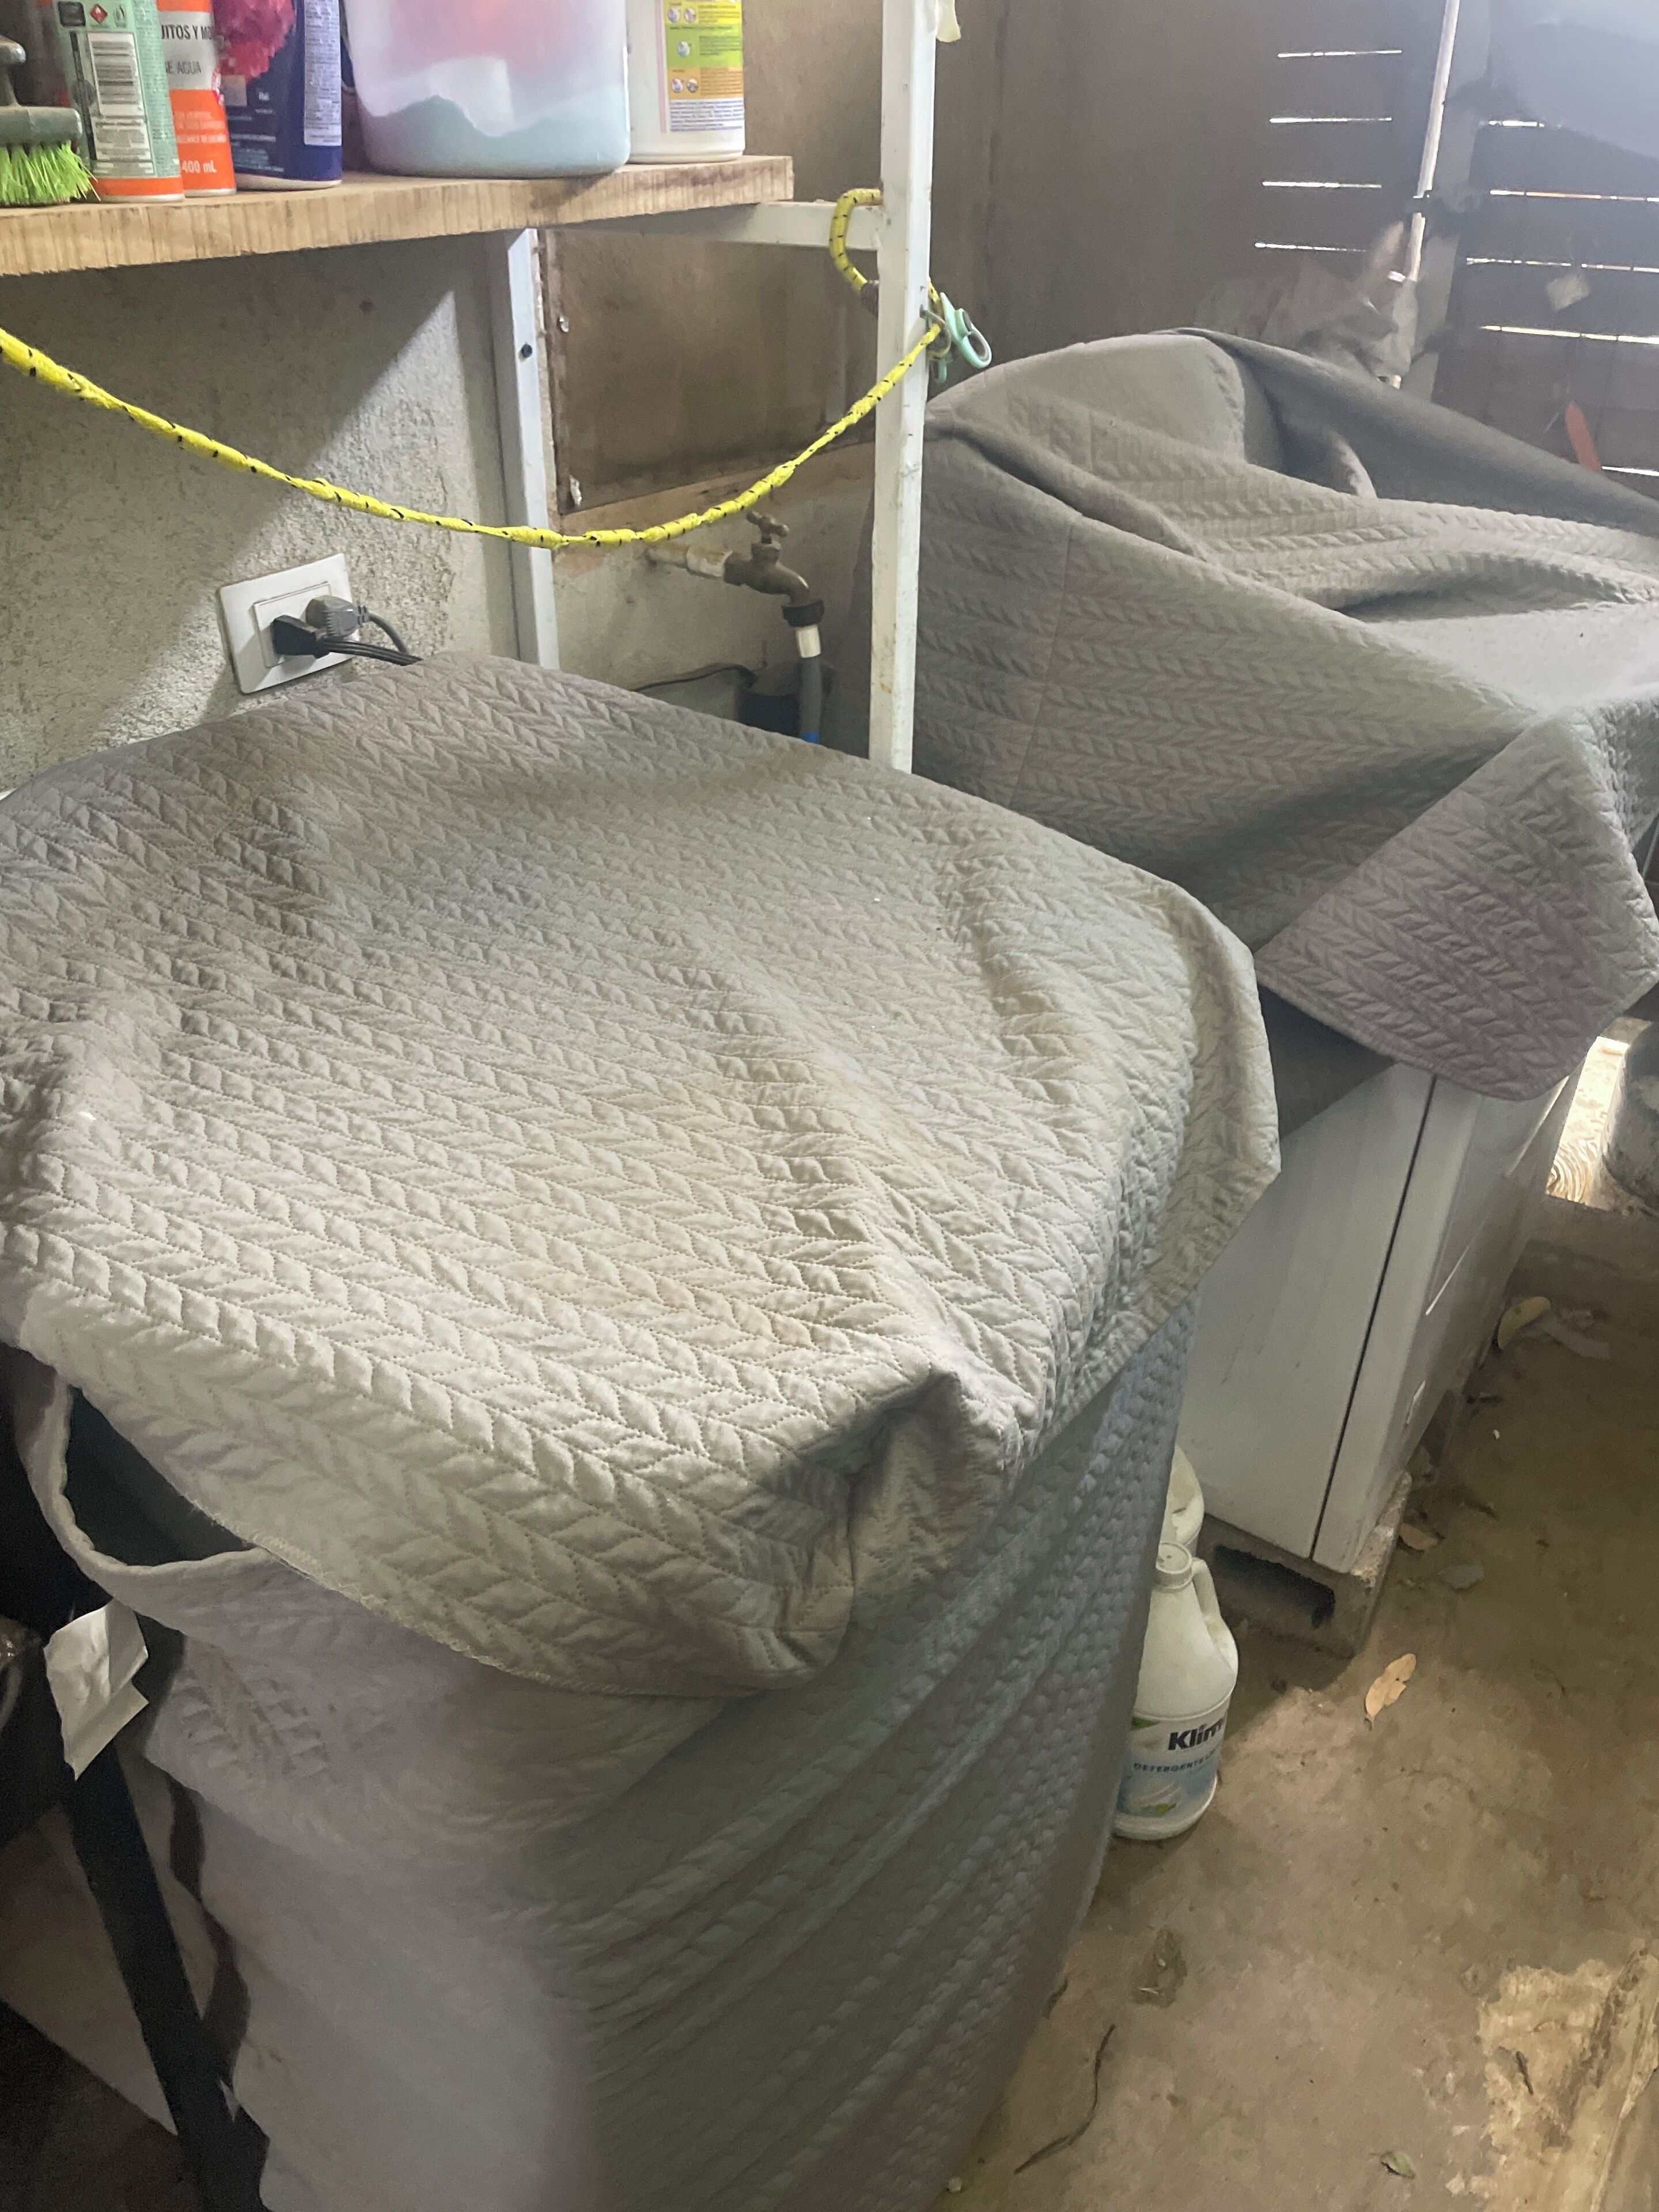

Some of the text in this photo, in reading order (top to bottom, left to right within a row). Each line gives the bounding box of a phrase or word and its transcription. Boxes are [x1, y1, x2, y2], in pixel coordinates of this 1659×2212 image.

[192, 25, 198, 40] Y
[177, 60, 202, 74] AGUA
[181, 160, 217, 173] 400 mL
